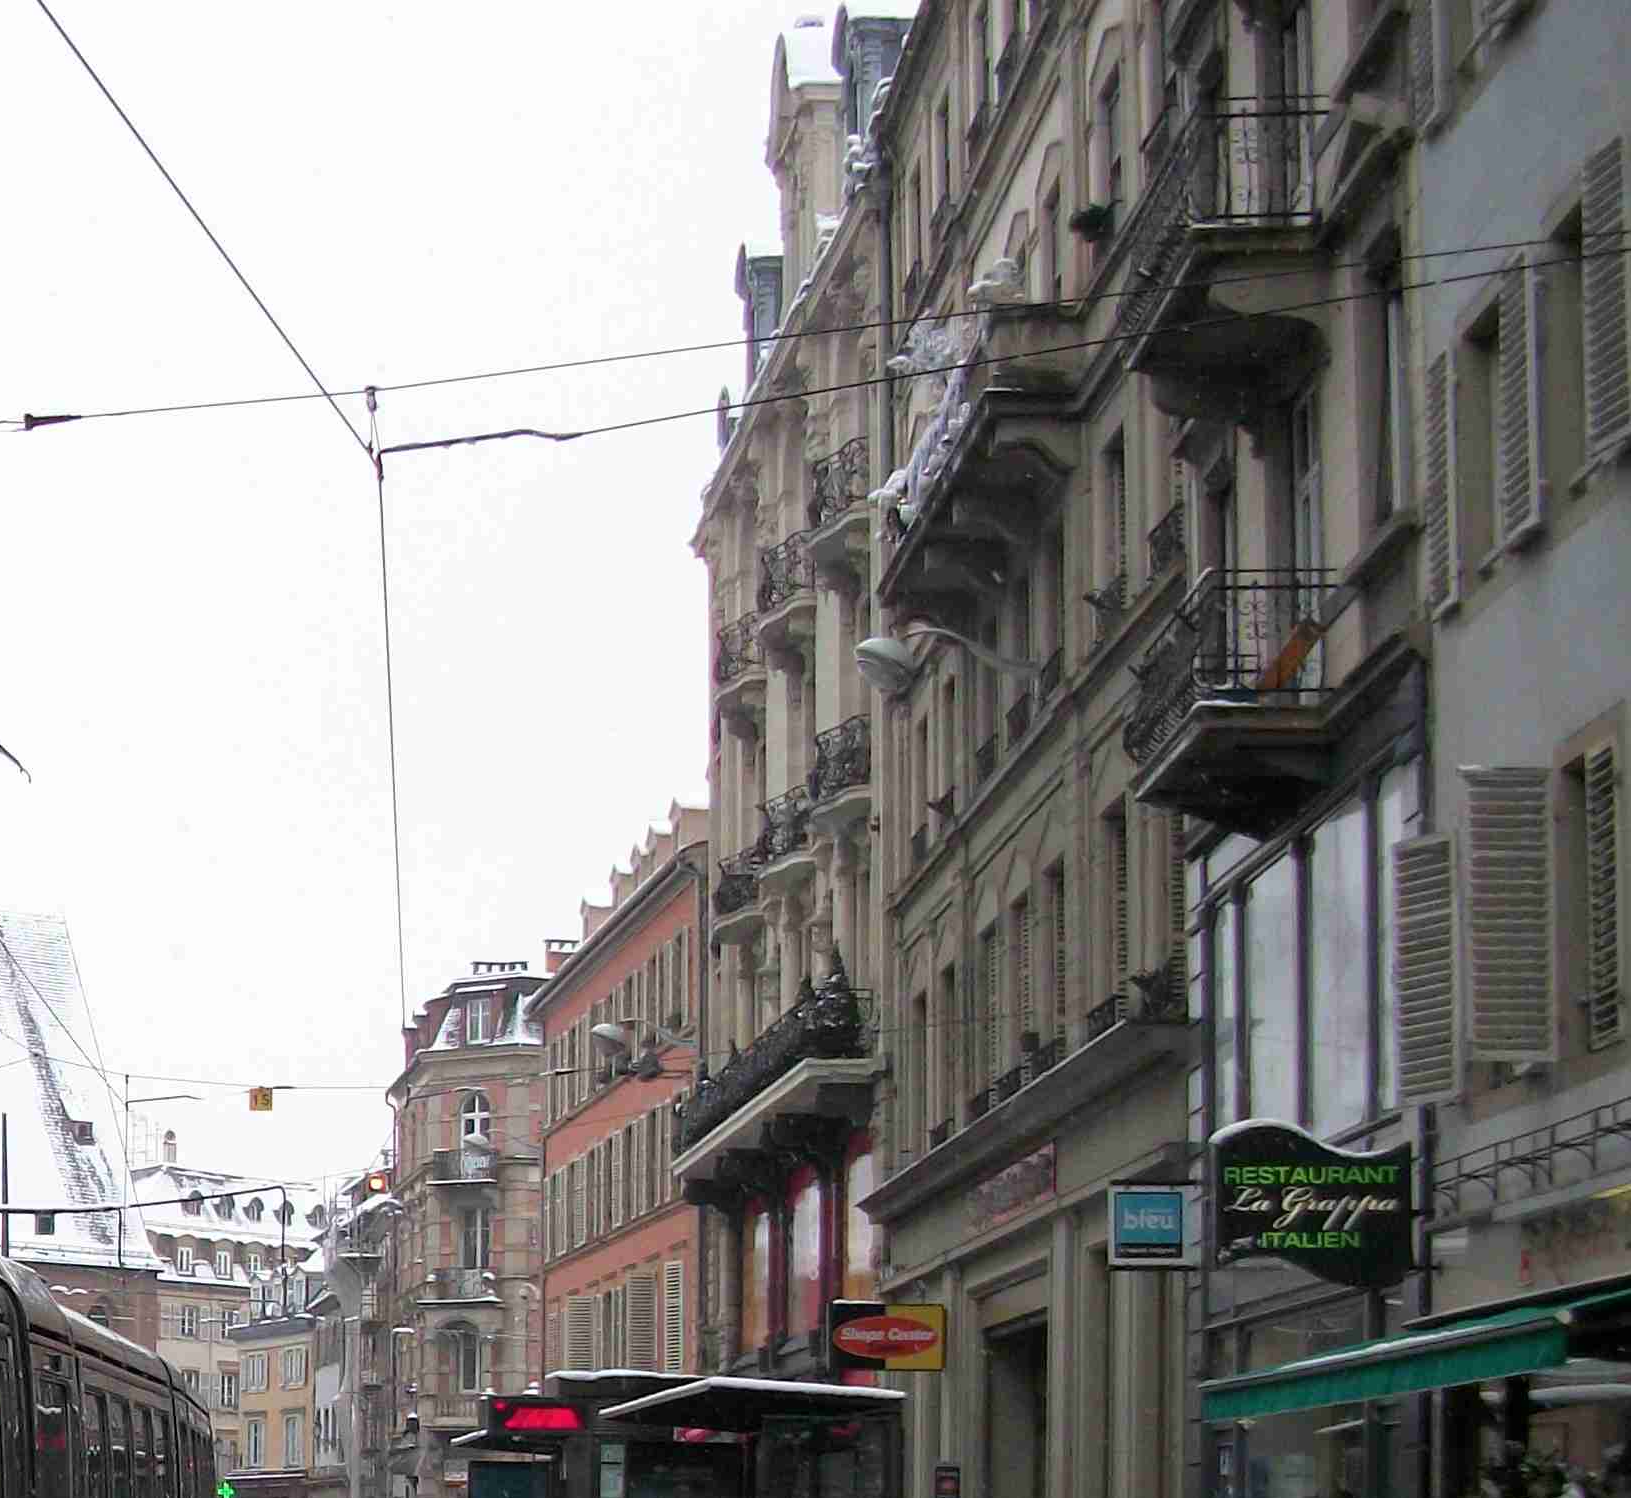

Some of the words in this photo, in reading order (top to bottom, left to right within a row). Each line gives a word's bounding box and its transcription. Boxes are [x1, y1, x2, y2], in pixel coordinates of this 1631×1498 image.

[1224, 1166, 1399, 1185] RESTAURANT
[1224, 1186, 1270, 1212] La
[1272, 1187, 1399, 1230] Grappa
[1123, 1208, 1176, 1230] bleu
[1261, 1232, 1361, 1249] ITALIEN
